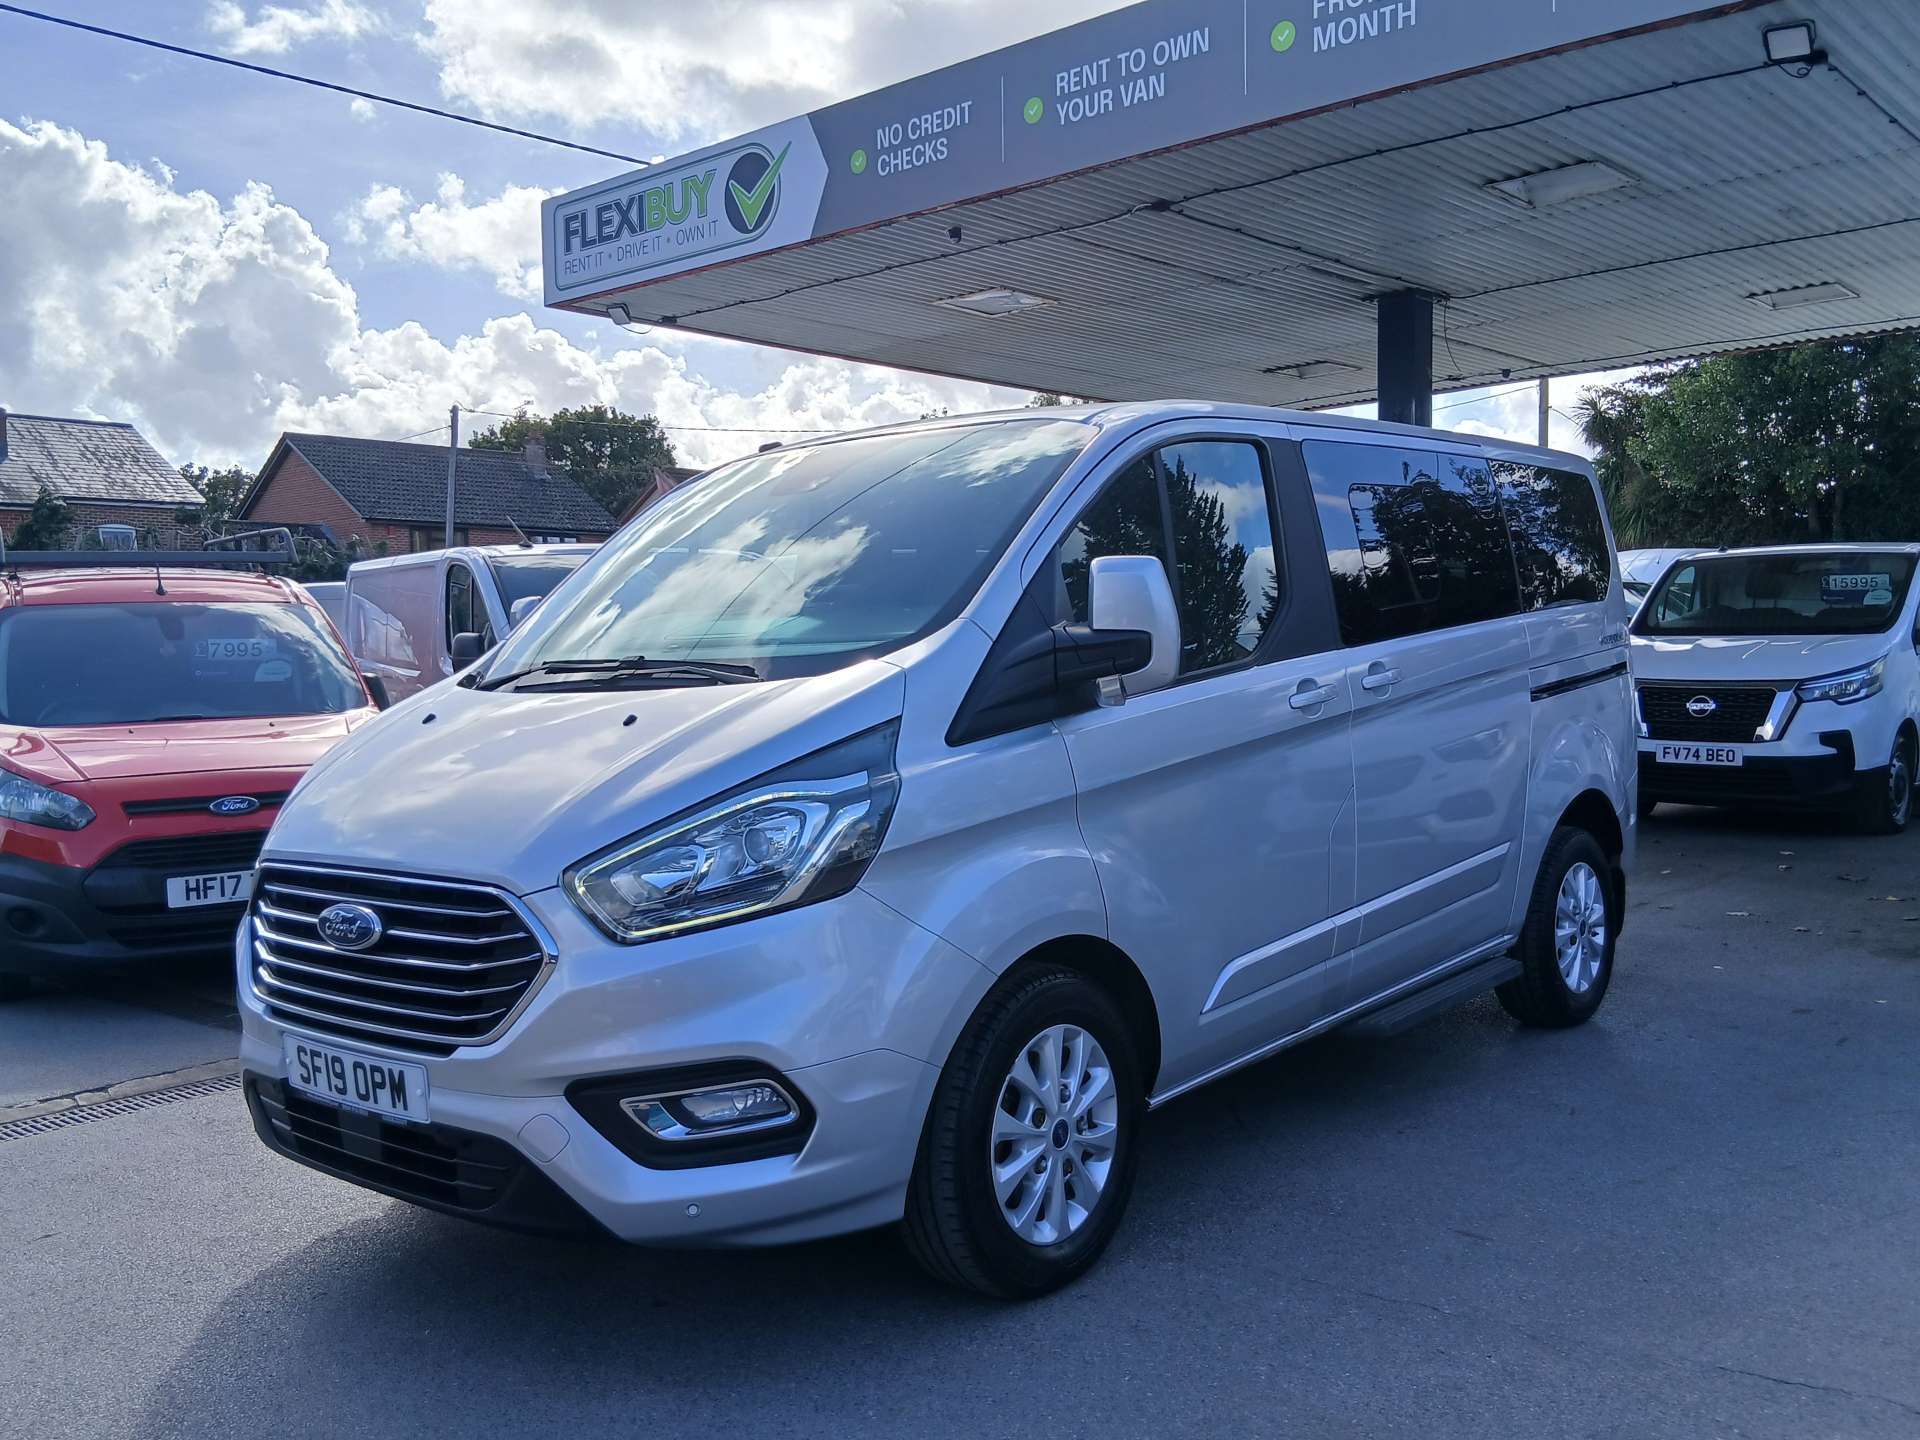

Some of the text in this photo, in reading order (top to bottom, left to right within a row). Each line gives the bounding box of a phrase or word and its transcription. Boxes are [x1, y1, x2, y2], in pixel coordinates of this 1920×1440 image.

[1312, 0, 1416, 53] MONTH
[1056, 27, 1209, 97] RENT TO OWN
[1056, 72, 1165, 126] YOUR VAN
[876, 101, 973, 151] NO CREDIT
[877, 137, 948, 177] CHECKS
[563, 169, 717, 257] FLEXIBUY
[564, 219, 719, 276] RENT IT DRIVE IT OWN IT
[1662, 746, 1736, 763] FV74 BEO
[221, 799, 249, 811] Ford
[184, 874, 242, 901] HF17
[325, 910, 361, 938] Ford
[296, 1045, 409, 1111] SF19 OPM
